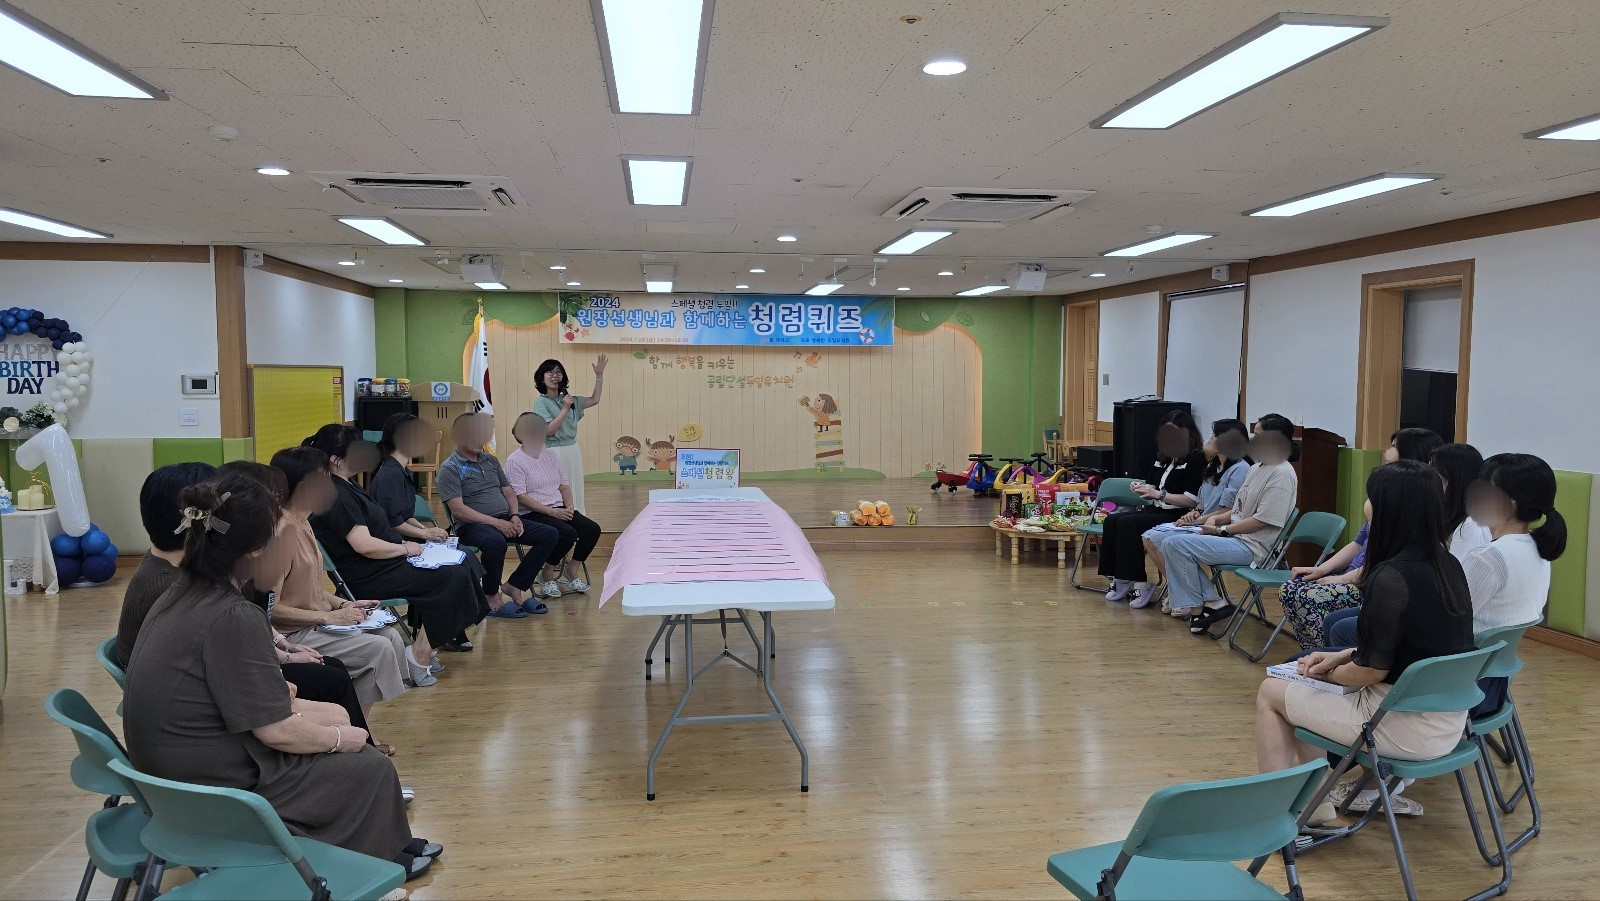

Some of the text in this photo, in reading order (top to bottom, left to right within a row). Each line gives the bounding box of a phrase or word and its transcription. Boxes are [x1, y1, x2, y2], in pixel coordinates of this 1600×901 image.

[589, 296, 620, 308] 2024
[671, 299, 696, 309] 스페셜
[698, 299, 714, 310] 청렴
[577, 309, 746, 330] 원장선생님과 함께하는
[750, 302, 862, 334] 청렴퀴즈
[0, 360, 60, 378] BIRTH
[648, 354, 735, 370] 함께 행복을 키우는
[7, 377, 44, 395] DAY
[704, 466, 735, 481] 청렴왕
